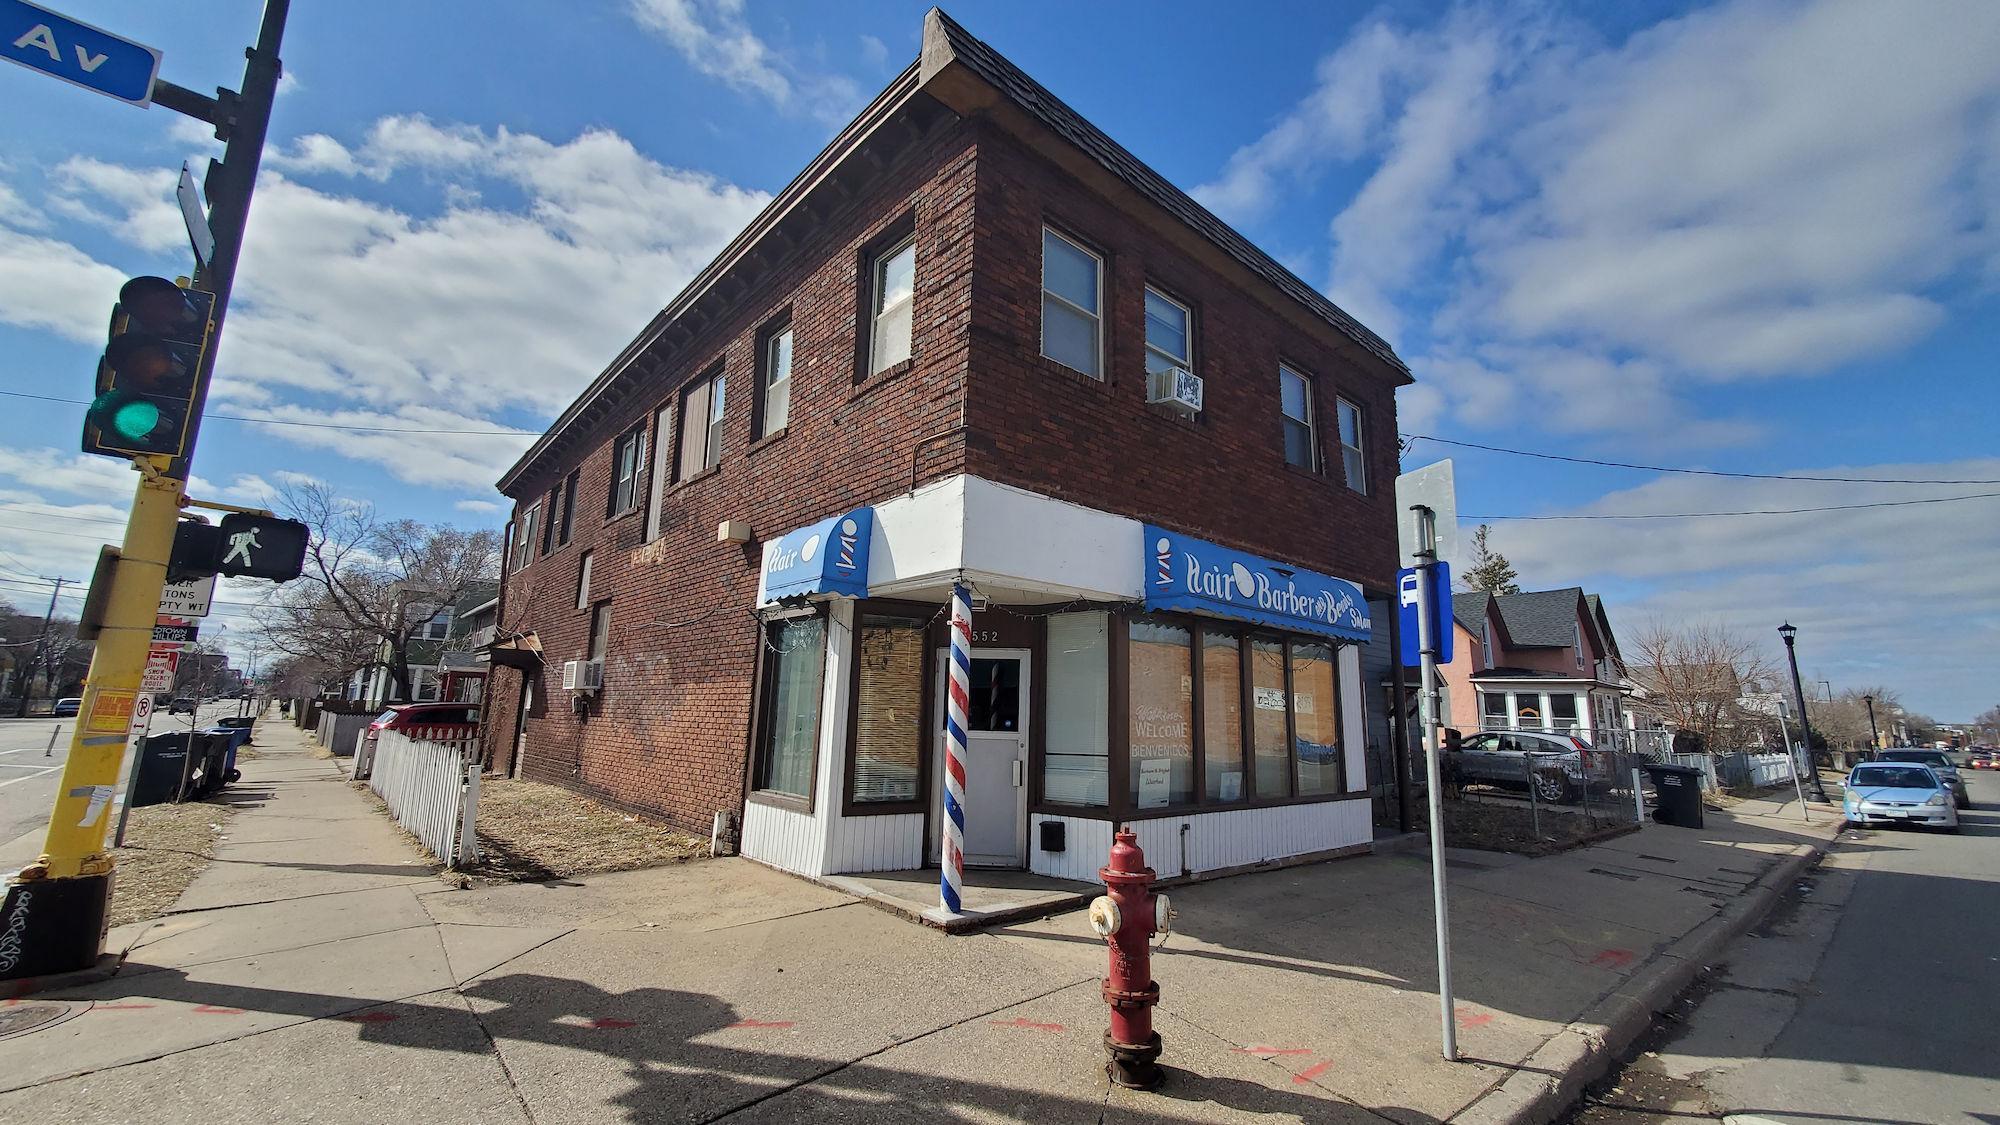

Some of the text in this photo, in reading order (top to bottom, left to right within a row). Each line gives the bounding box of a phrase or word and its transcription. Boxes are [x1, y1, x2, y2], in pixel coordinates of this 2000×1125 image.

[768, 547, 798, 573] Hair
[1184, 552, 1236, 601] Hair
[1255, 571, 1315, 619] Barber
[165, 590, 195, 599] TONS
[158, 601, 205, 611] PTY WT
[153, 633, 187, 641] HILLIPS
[1135, 722, 1188, 738] WELCOME
[1131, 743, 1189, 758] BIENVENIDOS
